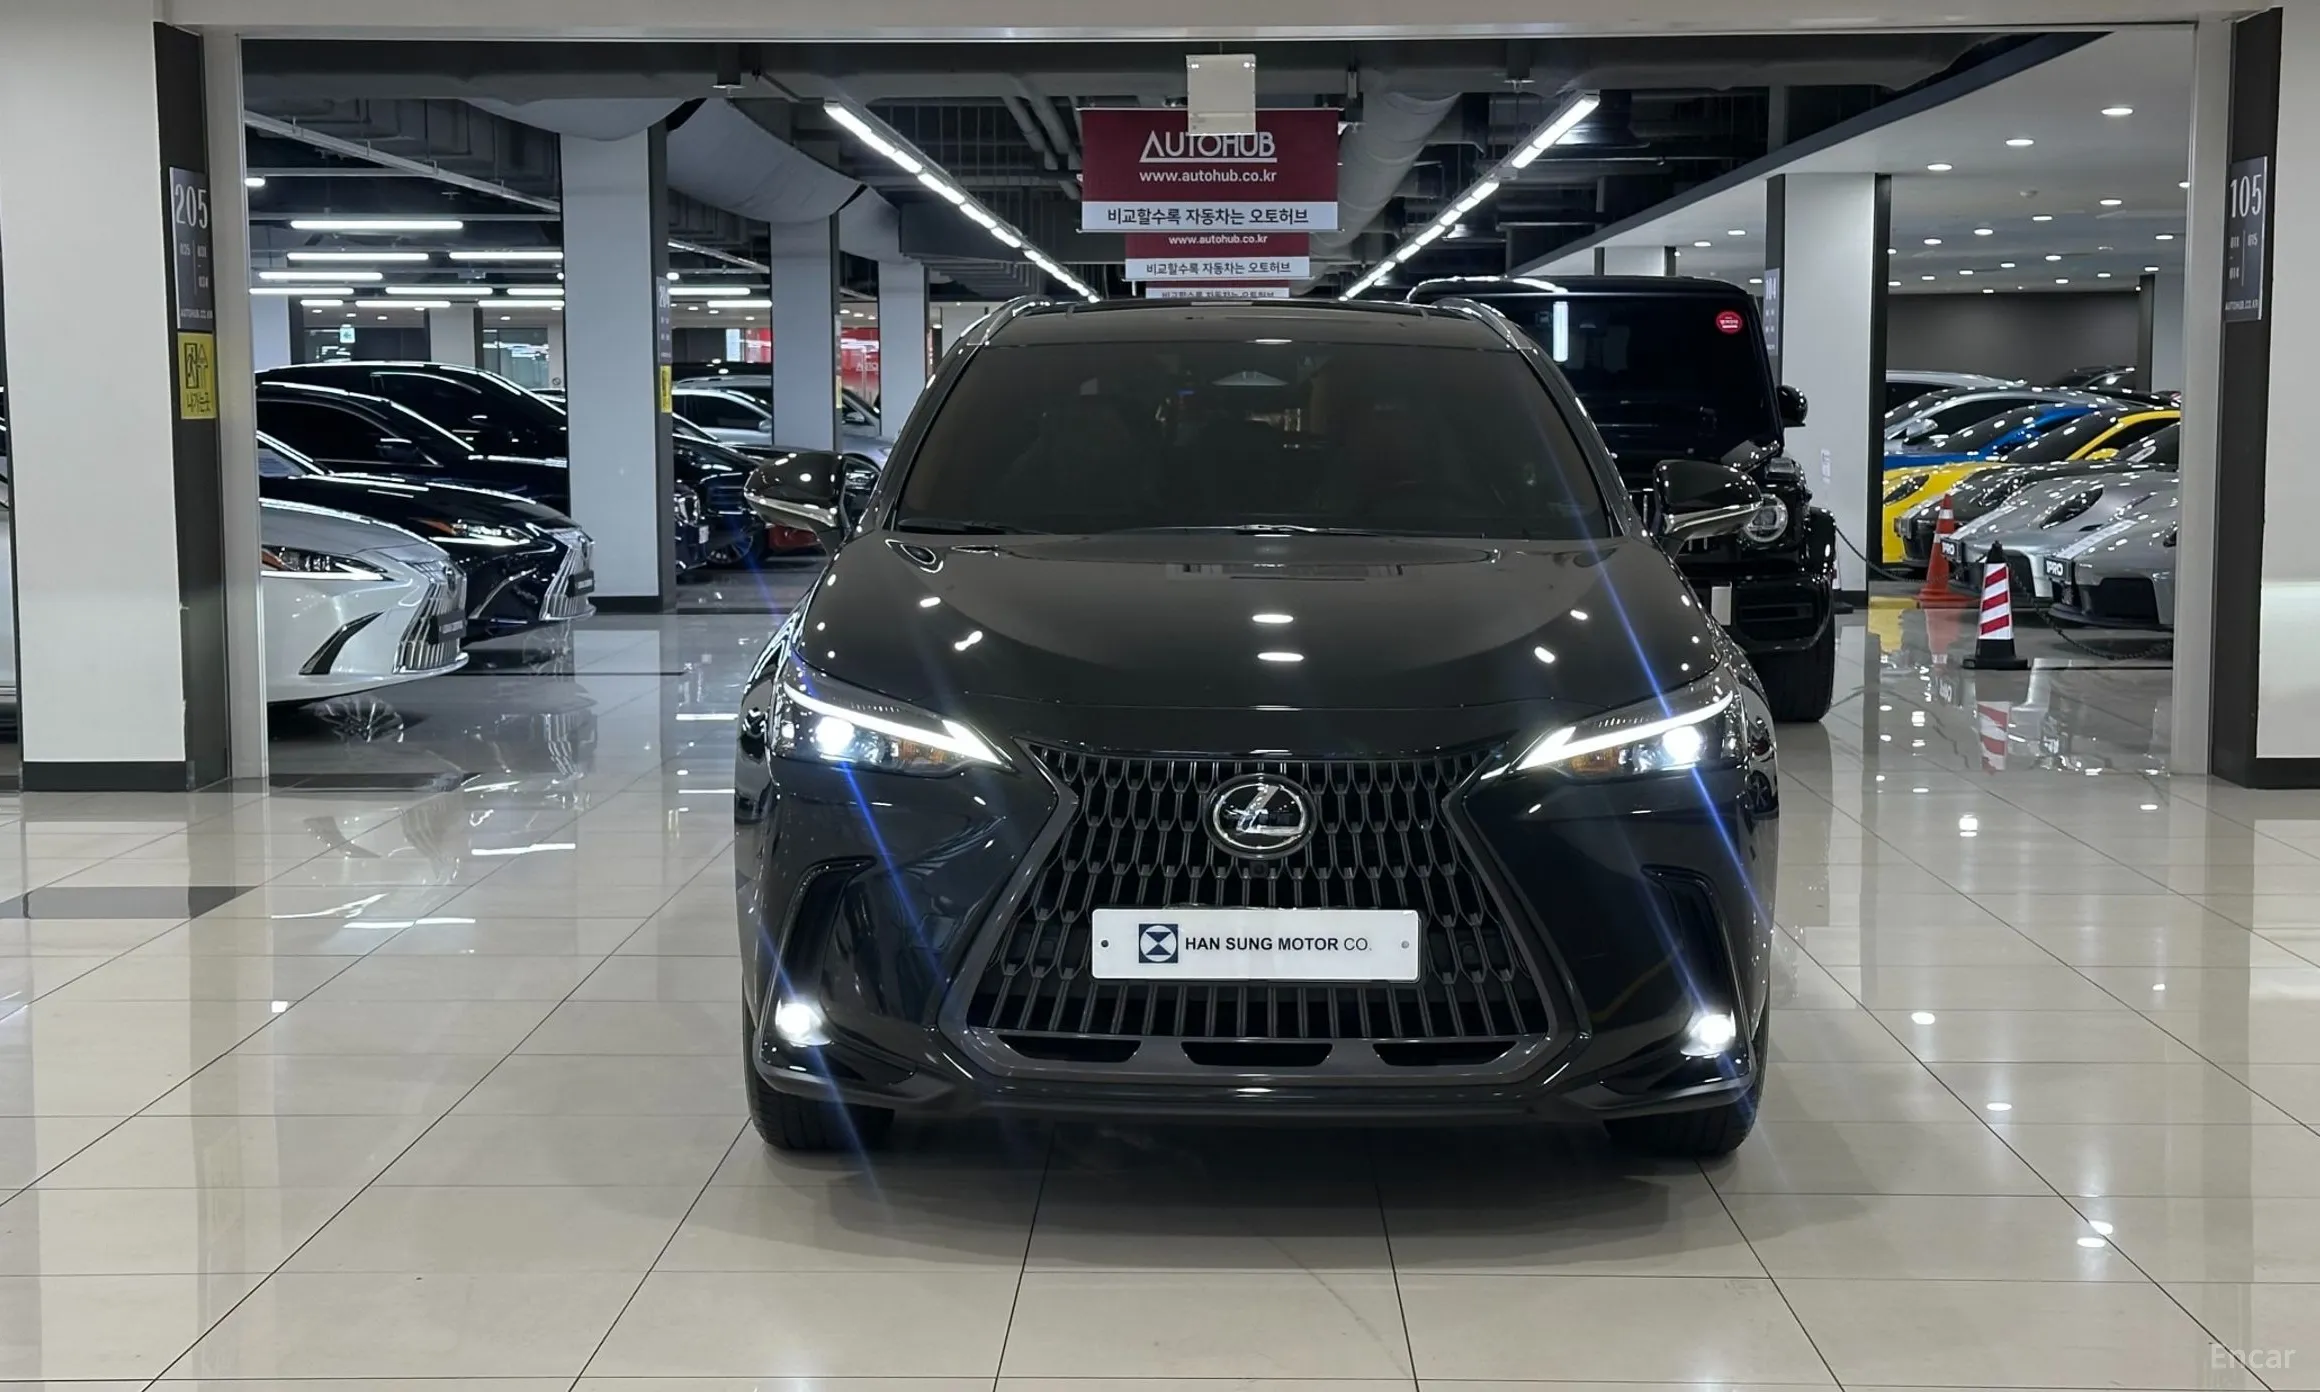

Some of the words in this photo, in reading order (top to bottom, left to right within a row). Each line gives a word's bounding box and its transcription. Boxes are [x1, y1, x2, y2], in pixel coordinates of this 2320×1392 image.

[1139, 130, 1277, 163] AUTOHUB
[1139, 169, 1277, 182] www.autohub.co.kr
[2230, 174, 2262, 218] 105
[175, 184, 208, 229] 205
[1107, 208, 1181, 225] 비교할수록
[1186, 208, 1245, 225] 자동차는
[1249, 208, 1309, 225] 오토허브
[1168, 234, 1268, 244] www.autohub.co.kr
[1146, 262, 1198, 275] 비교할수록
[1202, 262, 1245, 274] 자동차는
[1248, 262, 1291, 273] 오토허브
[2046, 560, 2063, 576] PRO
[1185, 937, 1220, 950] HAN
[1226, 937, 1273, 951] SUNG
[1278, 937, 1339, 951] MOTOR
[1344, 937, 1372, 951] CO.
